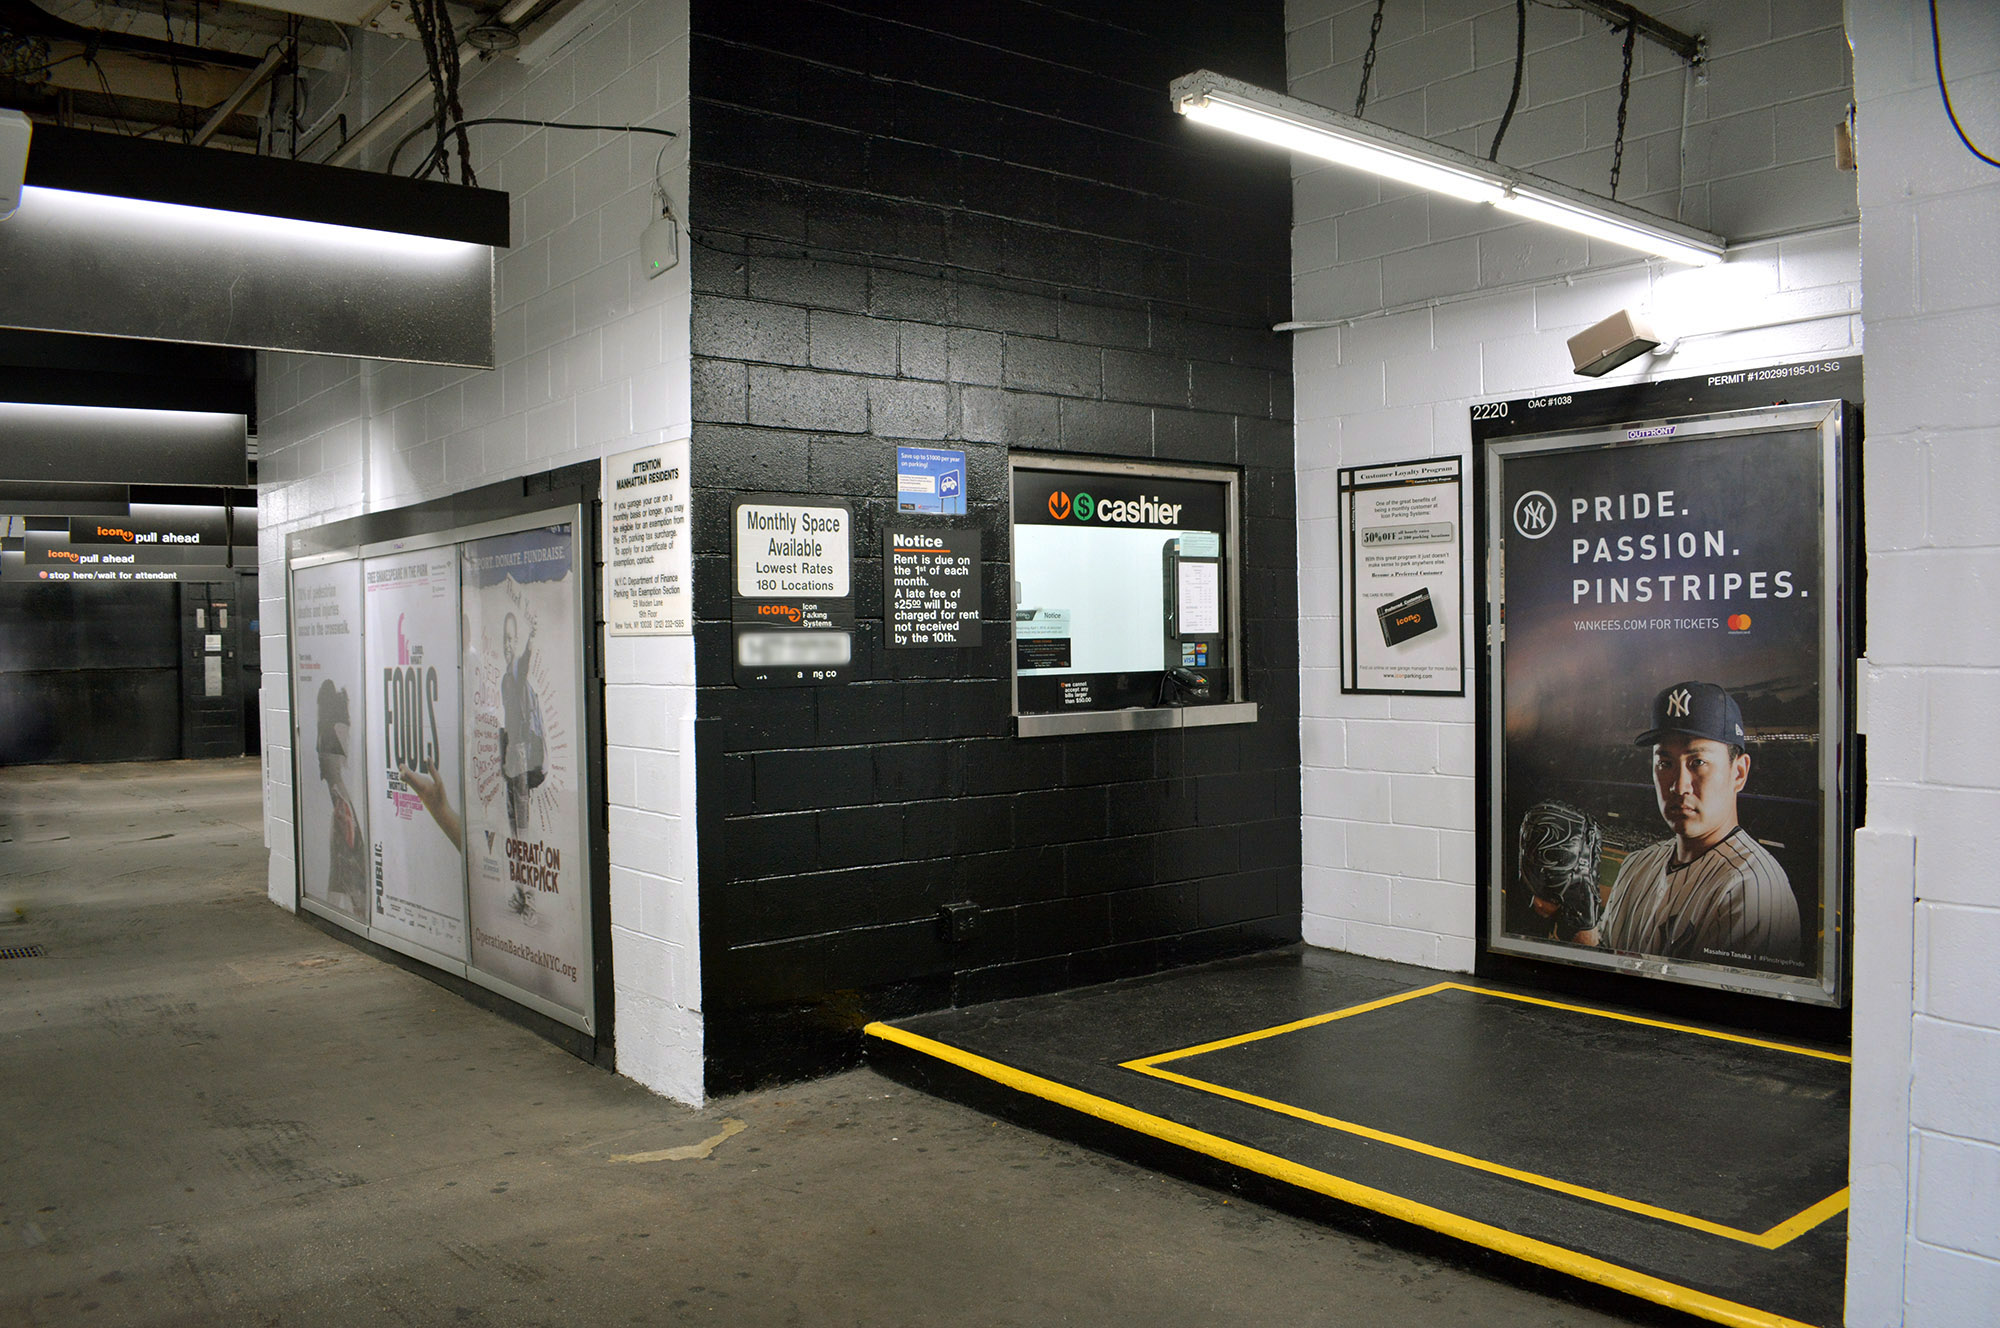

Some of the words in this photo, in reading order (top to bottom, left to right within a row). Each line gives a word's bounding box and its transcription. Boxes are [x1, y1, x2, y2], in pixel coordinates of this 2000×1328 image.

[1708, 373, 1746, 386] PERMIT
[1472, 402, 1508, 420] 2220
[1528, 399, 1547, 409] OAC
[1548, 395, 1573, 407] #1038
[632, 458, 661, 473] ATTENTION
[616, 474, 647, 490] MANHATTAN
[648, 468, 679, 484] RESIDENTS
[1360, 472, 1392, 480] Customer
[1394, 469, 1419, 477] Loyalty
[1421, 466, 1452, 474] Program
[1097, 495, 1182, 525] cashier
[1572, 490, 1688, 523] PRIDE.
[747, 511, 796, 534] Monthly
[802, 512, 840, 535] Space
[97, 526, 124, 536] icon
[135, 532, 158, 544] pull
[162, 532, 200, 544] ahead
[893, 534, 943, 547] Notice
[1364, 532, 1382, 543] 50%
[768, 537, 822, 557] Available
[1572, 530, 1740, 564] PASSION.
[48, 549, 70, 558] icon
[80, 554, 99, 564] pull
[102, 554, 135, 563] ahead
[523, 546, 566, 564] FUNDRAISE.
[894, 554, 918, 564] Rent
[921, 555, 931, 564] is
[934, 555, 954, 565] due
[756, 562, 797, 574] Lowest
[802, 562, 833, 574] Rates
[894, 566, 911, 575] the
[915, 566, 926, 575] 1st
[929, 566, 940, 575] of
[944, 566, 969, 575] each
[49, 571, 70, 580] stop
[73, 571, 116, 579] here/wait
[119, 571, 132, 579] for
[135, 571, 177, 579] attendant
[894, 576, 929, 586] month.
[756, 580, 777, 590] 180
[781, 580, 834, 591] Locations
[1573, 571, 1808, 604] PINSTRIPES.
[894, 588, 902, 598] A
[906, 589, 925, 598] late
[929, 589, 946, 598] fee
[950, 589, 961, 598] of
[924, 600, 940, 609] will
[944, 600, 957, 609] be
[894, 610, 937, 621] charged
[941, 610, 955, 619] for
[959, 610, 979, 619] rent
[803, 620, 832, 628] Systems
[894, 622, 912, 631] not
[916, 621, 959, 631] received
[1573, 619, 1647, 631] YANKEES.COM
[1650, 619, 1671, 630] FOR
[1673, 618, 1719, 630] TICKETS
[895, 633, 907, 645] by
[912, 633, 928, 643] the
[932, 632, 957, 642] 10th.
[384, 666, 440, 774] FOOLS
[375, 841, 384, 914] PUBLIC.
[475, 927, 577, 983] OperationBackPackNYC.org
[1703, 947, 1730, 957] Masahiro
[1731, 951, 1752, 960] Tanaka
